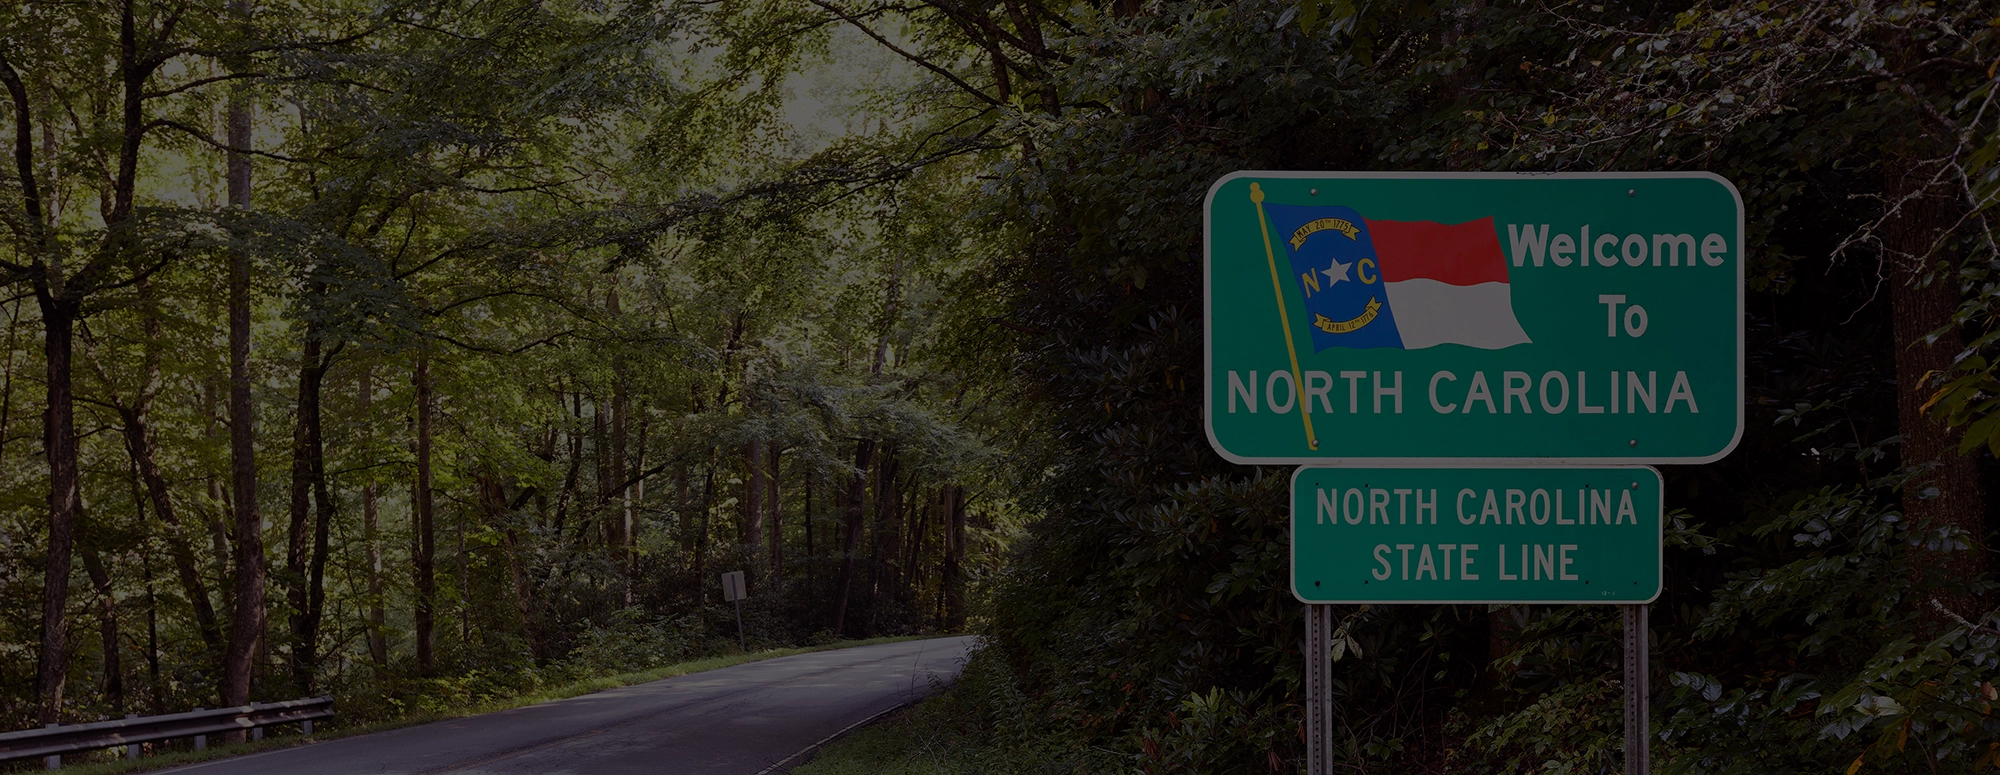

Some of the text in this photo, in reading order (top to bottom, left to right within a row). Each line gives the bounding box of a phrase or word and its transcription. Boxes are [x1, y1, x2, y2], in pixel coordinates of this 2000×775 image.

[1296, 225, 1312, 239] MAY
[1333, 219, 1350, 231] 1775
[1507, 223, 1727, 267] Welcome
[1301, 257, 1377, 299] N C
[1326, 323, 1346, 332] APRIL
[1361, 311, 1374, 324] 1776
[1598, 294, 1649, 338] To
[1227, 370, 1700, 415] NORTH CAROLINA
[1316, 488, 1638, 525] NORTH CAROLINA
[1371, 543, 1579, 581] STATE LINE
